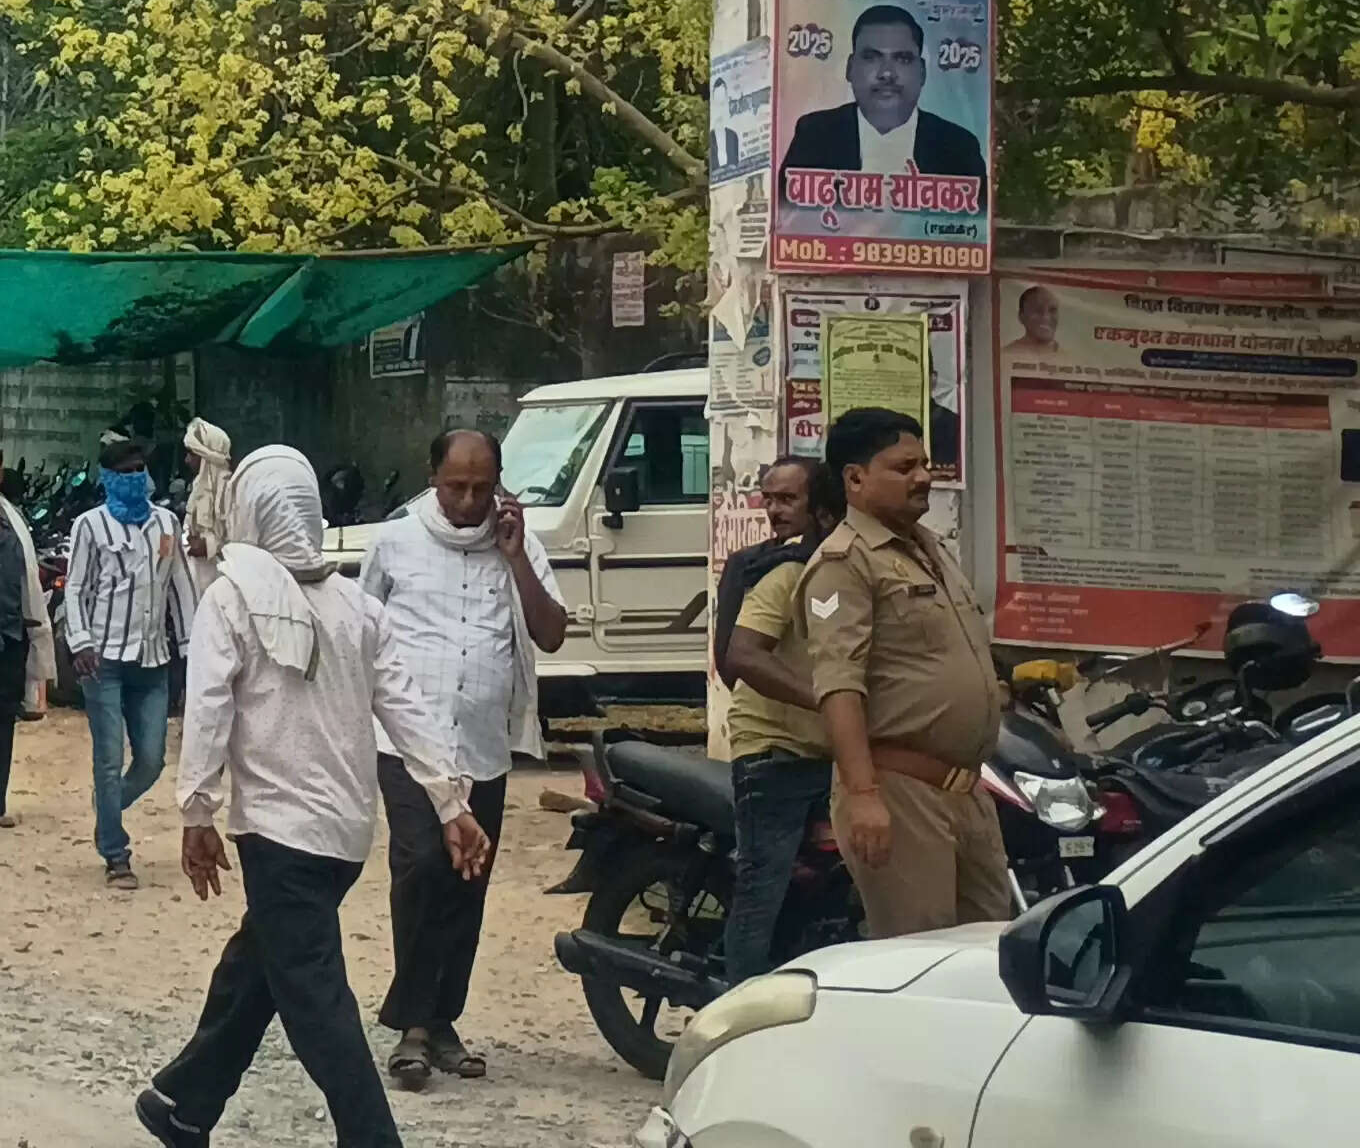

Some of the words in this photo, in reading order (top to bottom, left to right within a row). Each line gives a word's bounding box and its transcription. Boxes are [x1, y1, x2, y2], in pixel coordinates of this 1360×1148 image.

[787, 28, 832, 55] 2025
[938, 43, 980, 69] 2025
[840, 173, 885, 210] राम
[889, 157, 980, 213] सोनकर
[780, 238, 833, 261] Mob.
